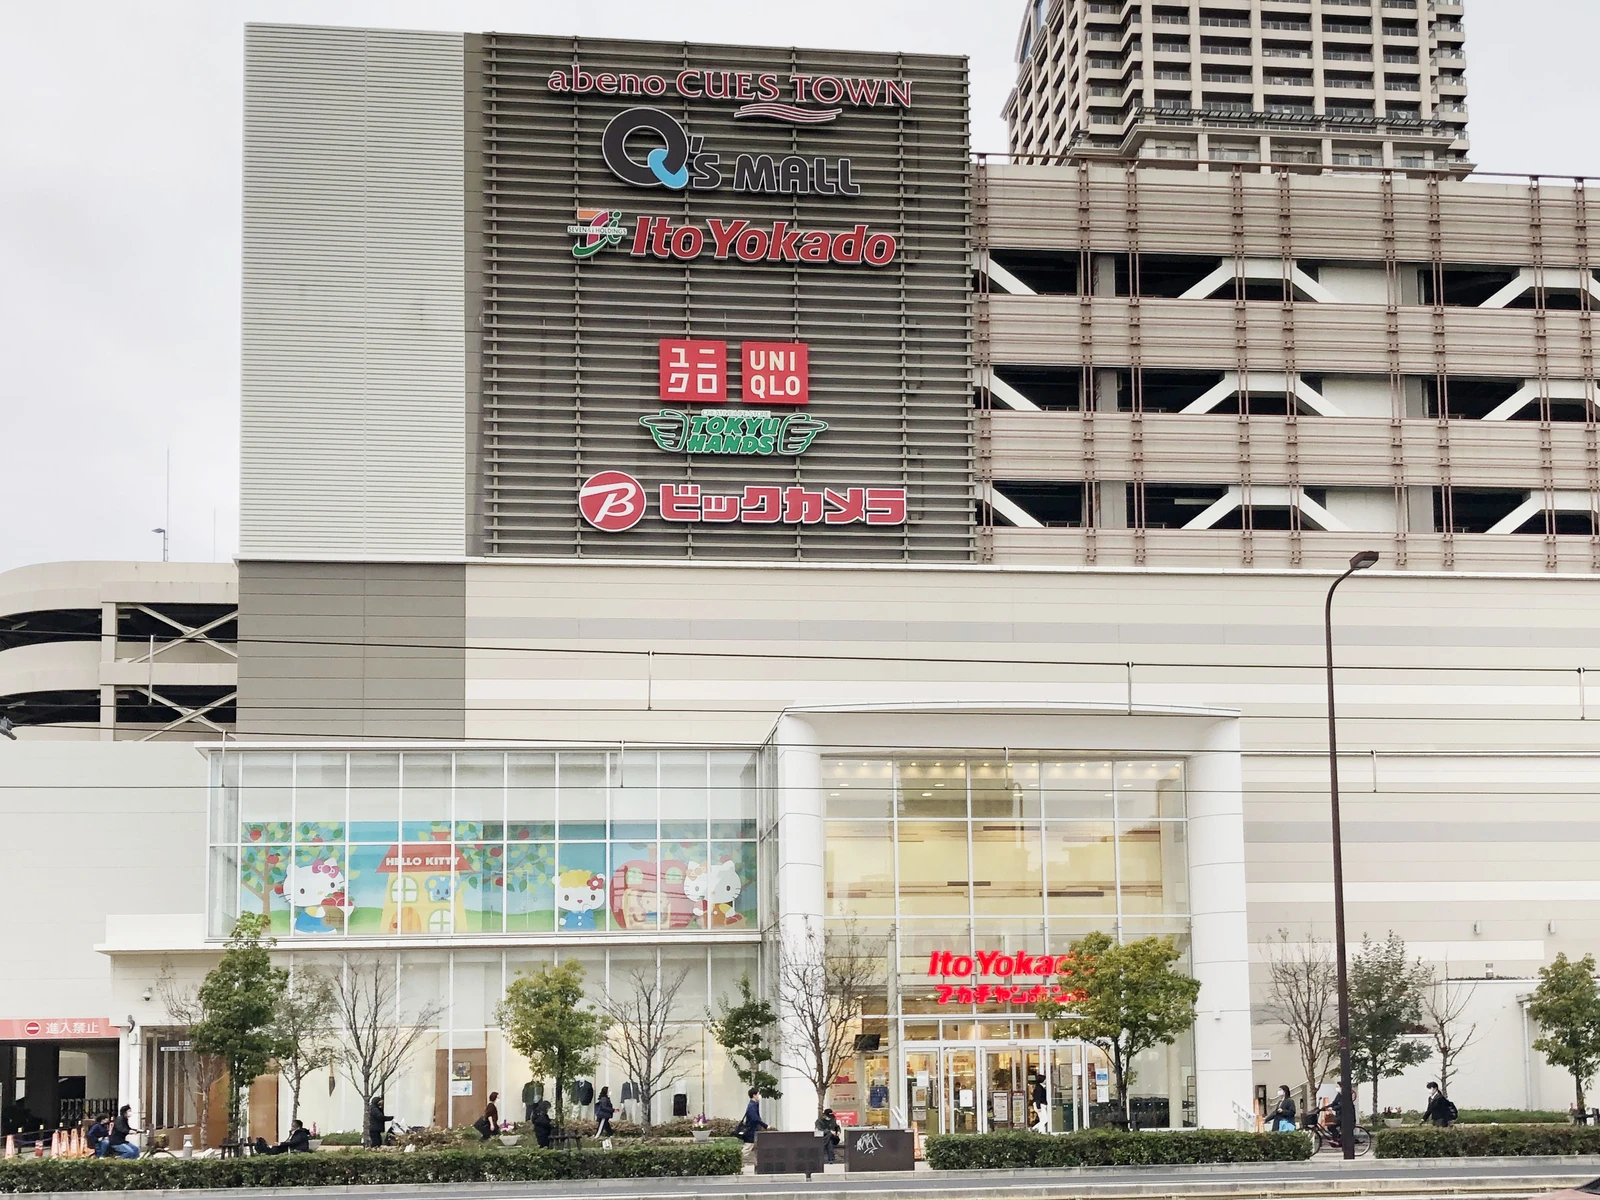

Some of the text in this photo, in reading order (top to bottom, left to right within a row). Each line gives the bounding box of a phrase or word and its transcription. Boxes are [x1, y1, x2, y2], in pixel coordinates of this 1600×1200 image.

[547, 65, 912, 109] abeno CUES TOWN
[733, 154, 860, 195] MALL
[750, 350, 796, 372] UNI
[750, 375, 800, 399] QLO
[691, 416, 780, 436] TOKYU
[687, 434, 775, 455] HANDS
[659, 483, 907, 525] ビックカメラ
[425, 856, 461, 866] KITTY
[45, 1021, 99, 1035] 進入禁止
